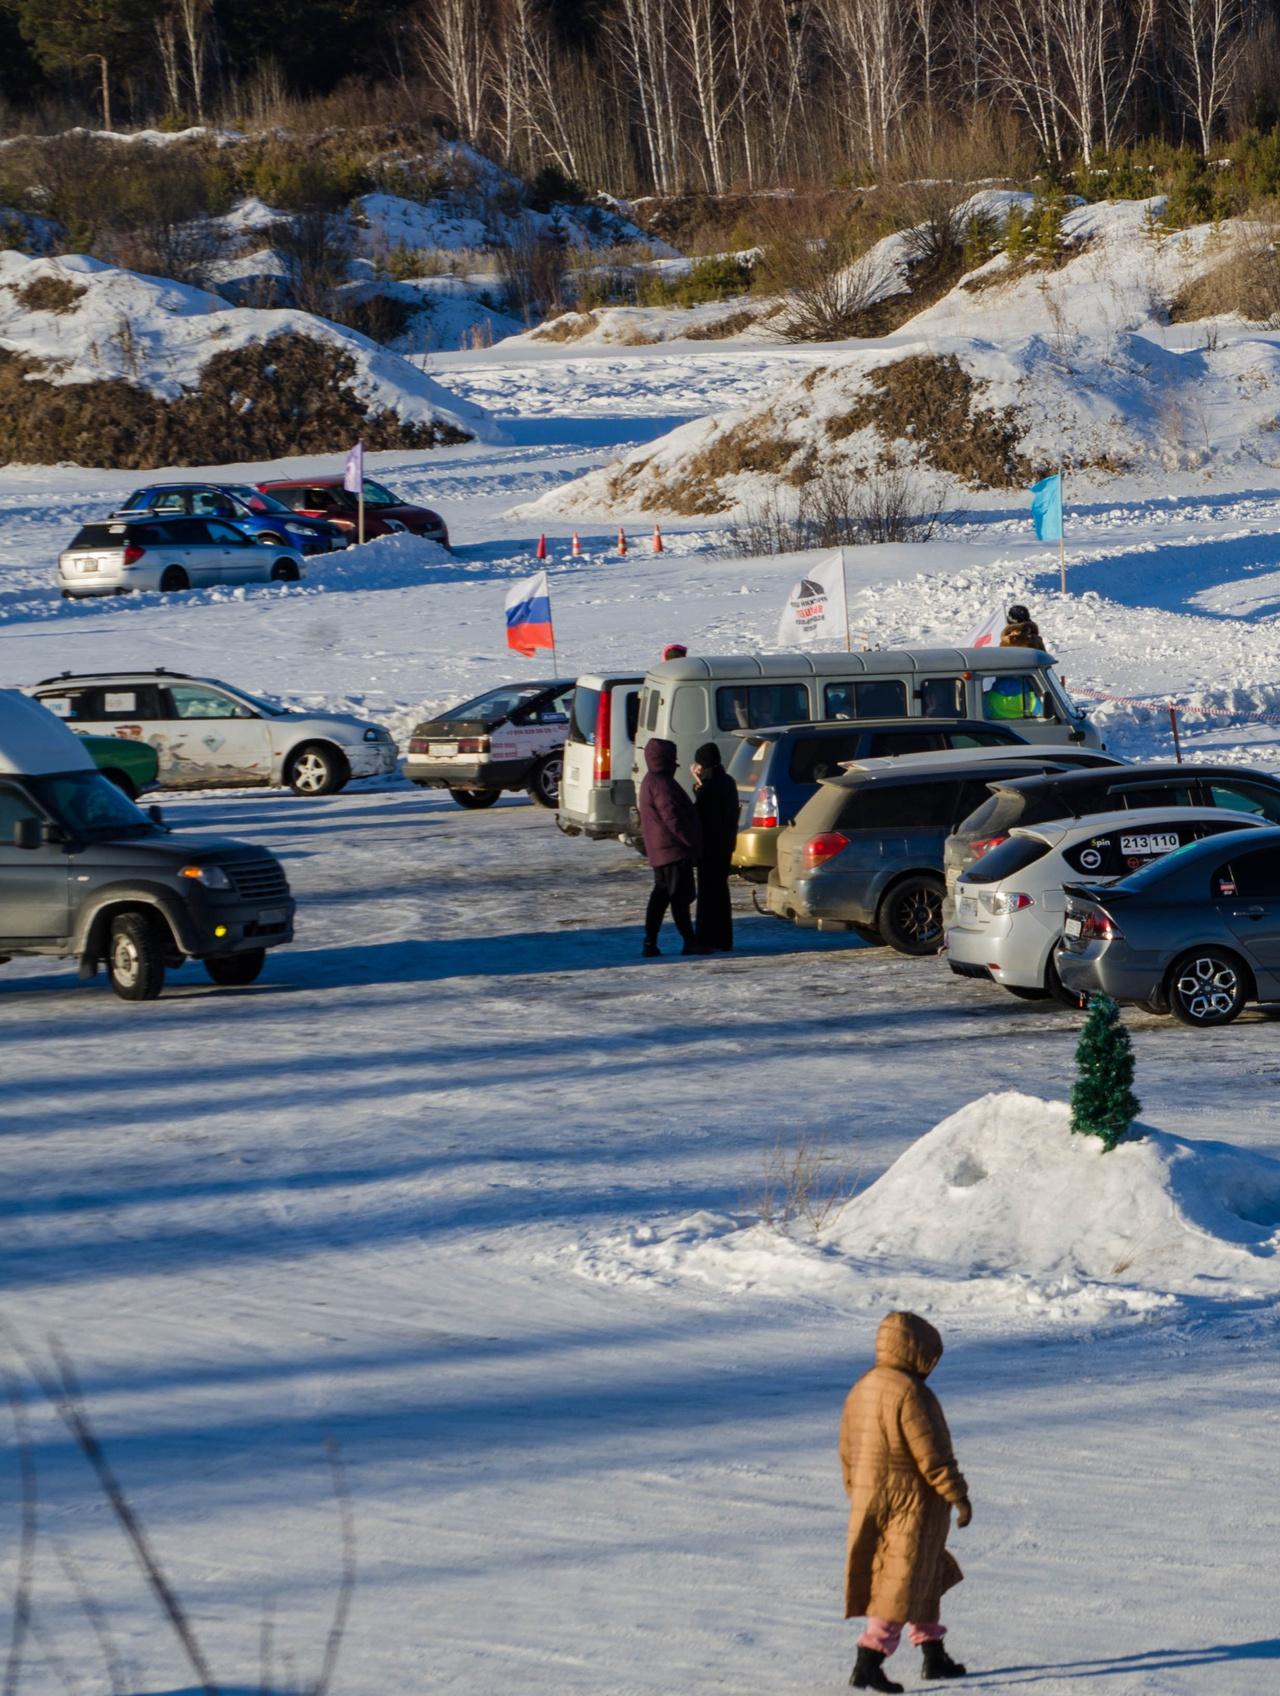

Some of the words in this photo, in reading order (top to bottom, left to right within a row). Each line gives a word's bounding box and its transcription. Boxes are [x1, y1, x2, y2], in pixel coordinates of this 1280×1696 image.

[1091, 838, 1111, 848] Spin
[1123, 836, 1148, 848] 213
[1151, 835, 1177, 847] 110
